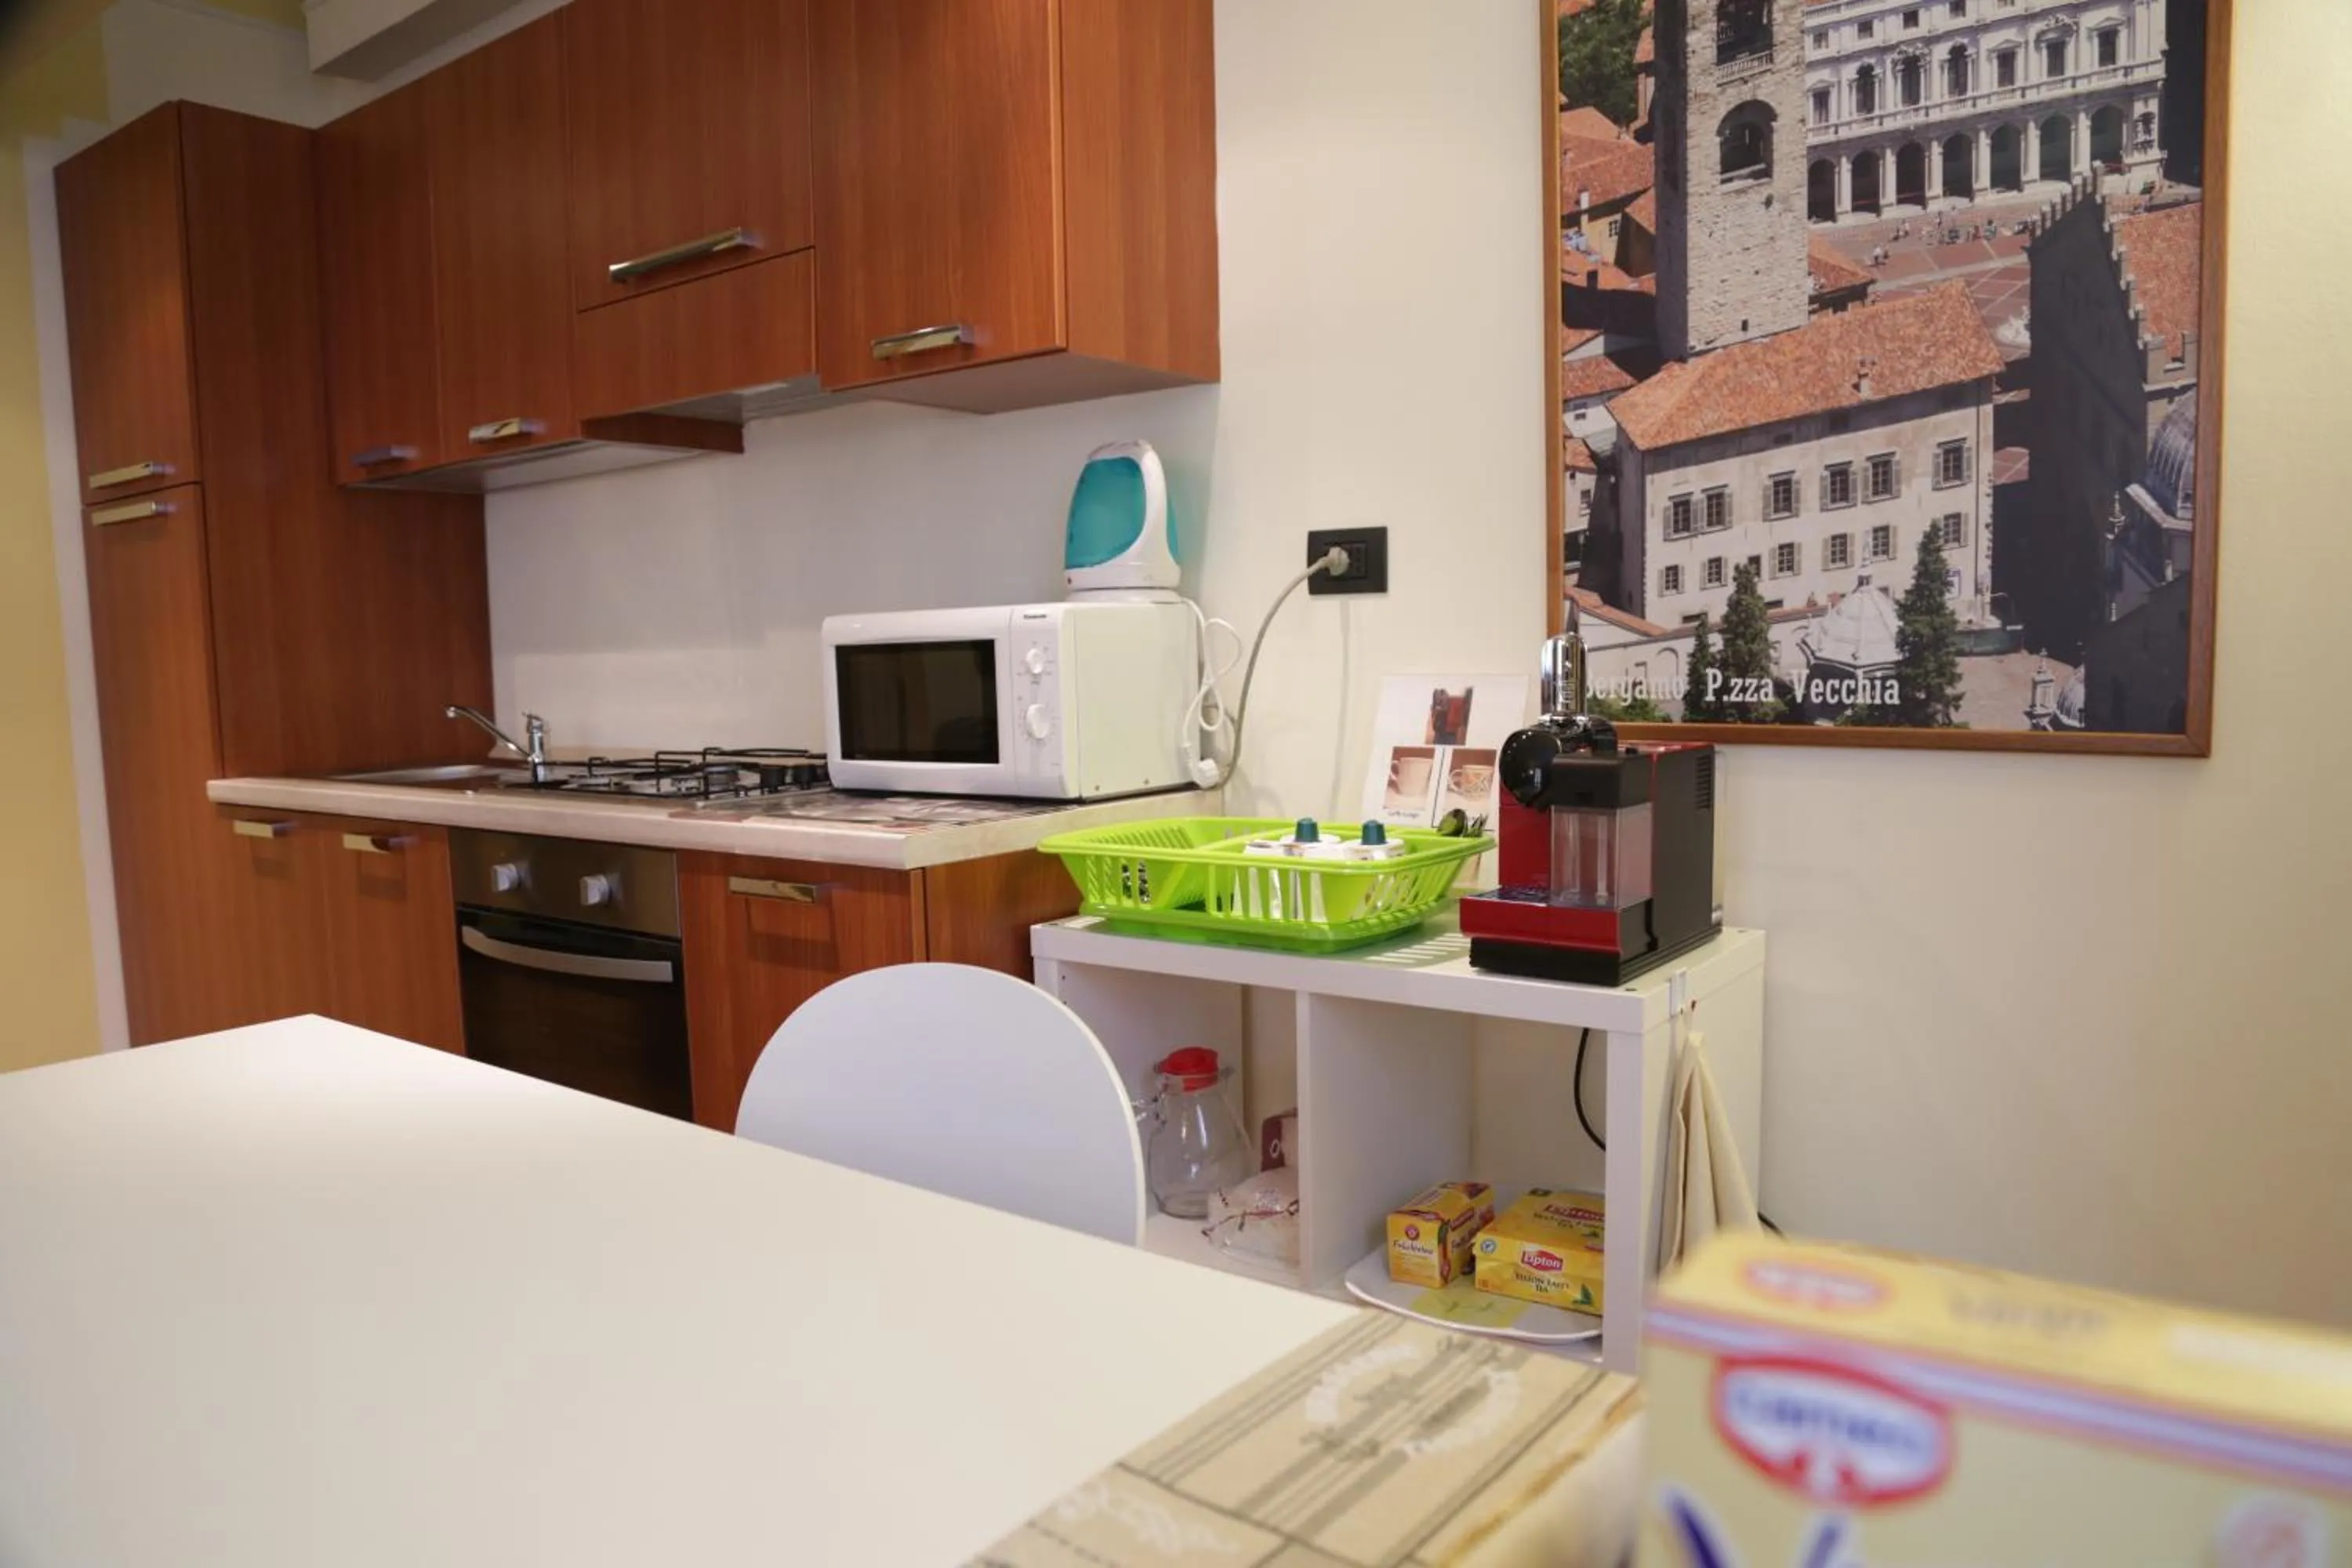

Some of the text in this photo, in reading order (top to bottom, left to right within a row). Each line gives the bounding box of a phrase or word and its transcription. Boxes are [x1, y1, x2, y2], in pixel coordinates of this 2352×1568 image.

[1704, 666, 1777, 702] P.zza
[1792, 667, 1901, 705] Vecchia
[1523, 1252, 1561, 1269] Lipton
